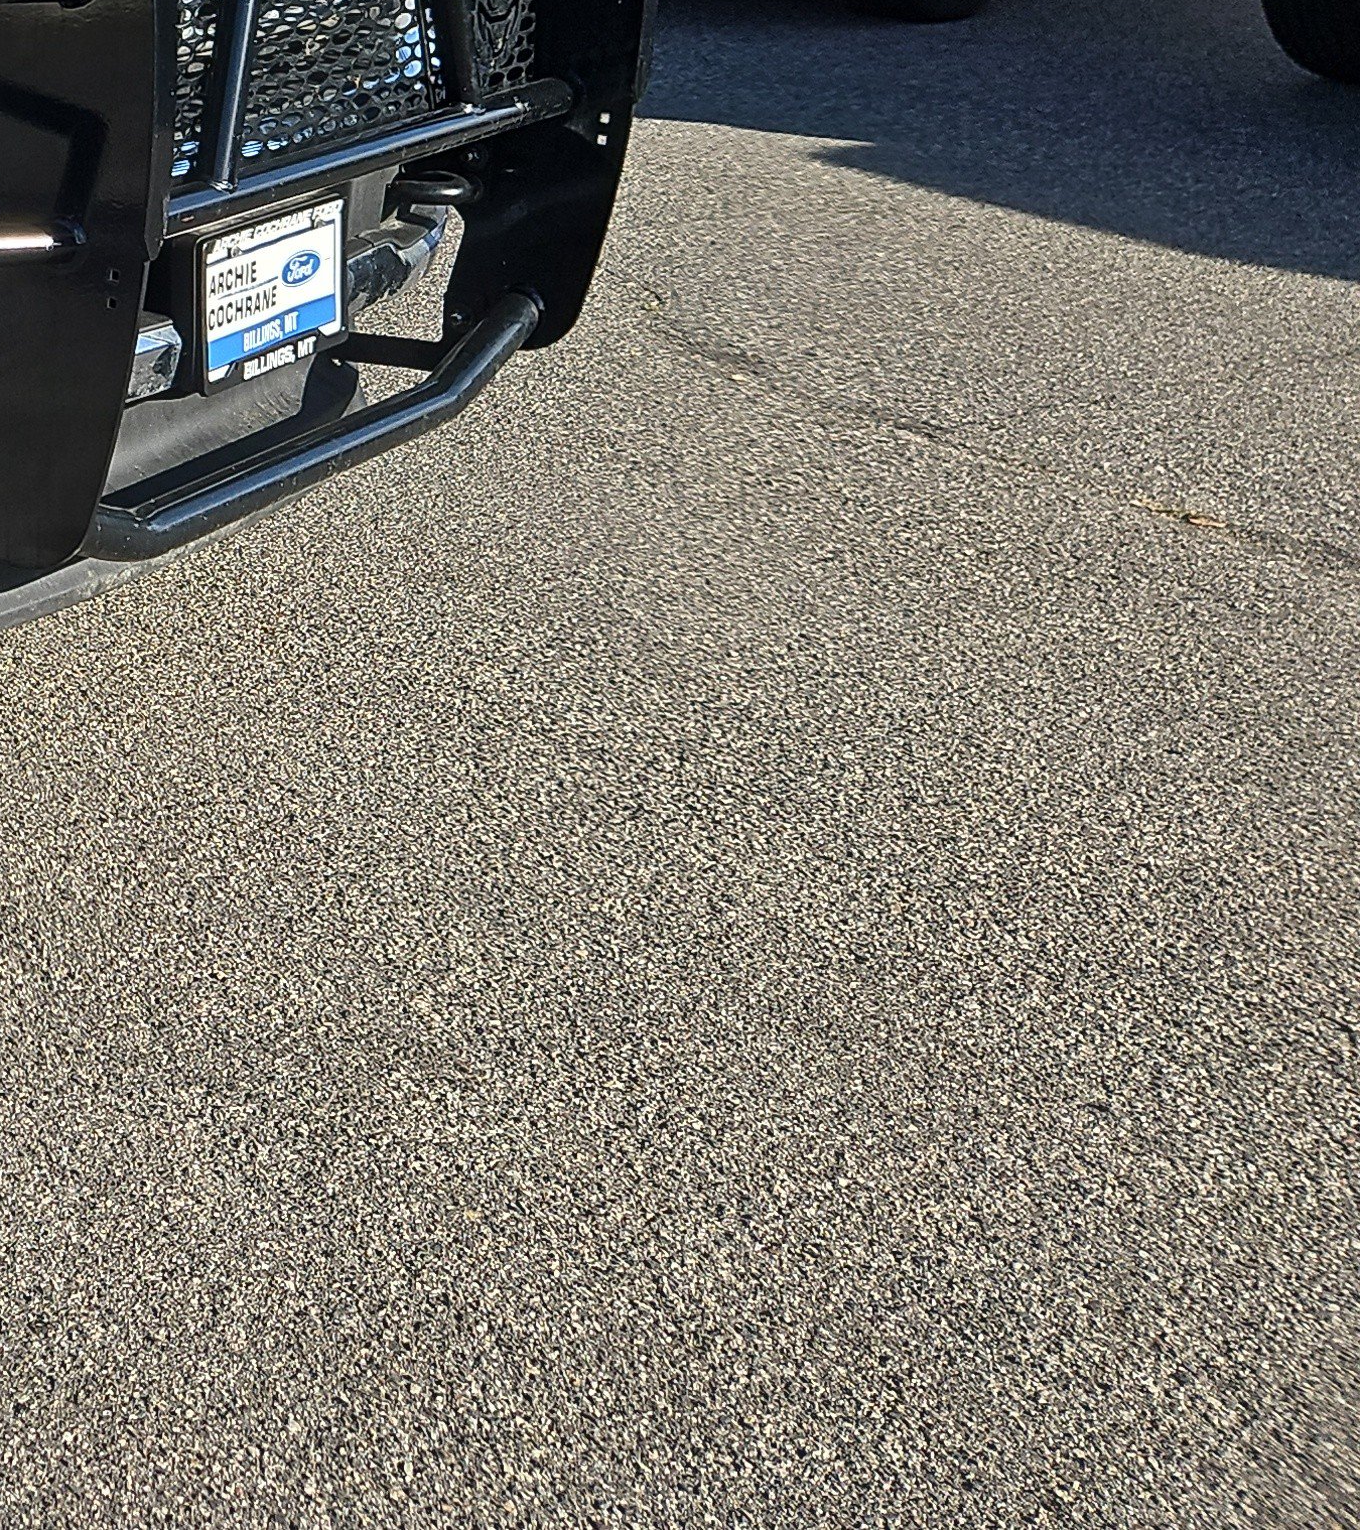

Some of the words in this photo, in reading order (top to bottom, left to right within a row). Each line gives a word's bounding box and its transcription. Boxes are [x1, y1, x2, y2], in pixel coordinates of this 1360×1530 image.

[209, 260, 257, 298] ARCHIE
[287, 255, 316, 283] Ford
[208, 285, 278, 331] COCHRANE
[243, 318, 283, 353] BILLINGS,
[284, 311, 299, 334] MT
[243, 344, 296, 381] BILLINGS,
[297, 336, 317, 359] MT
